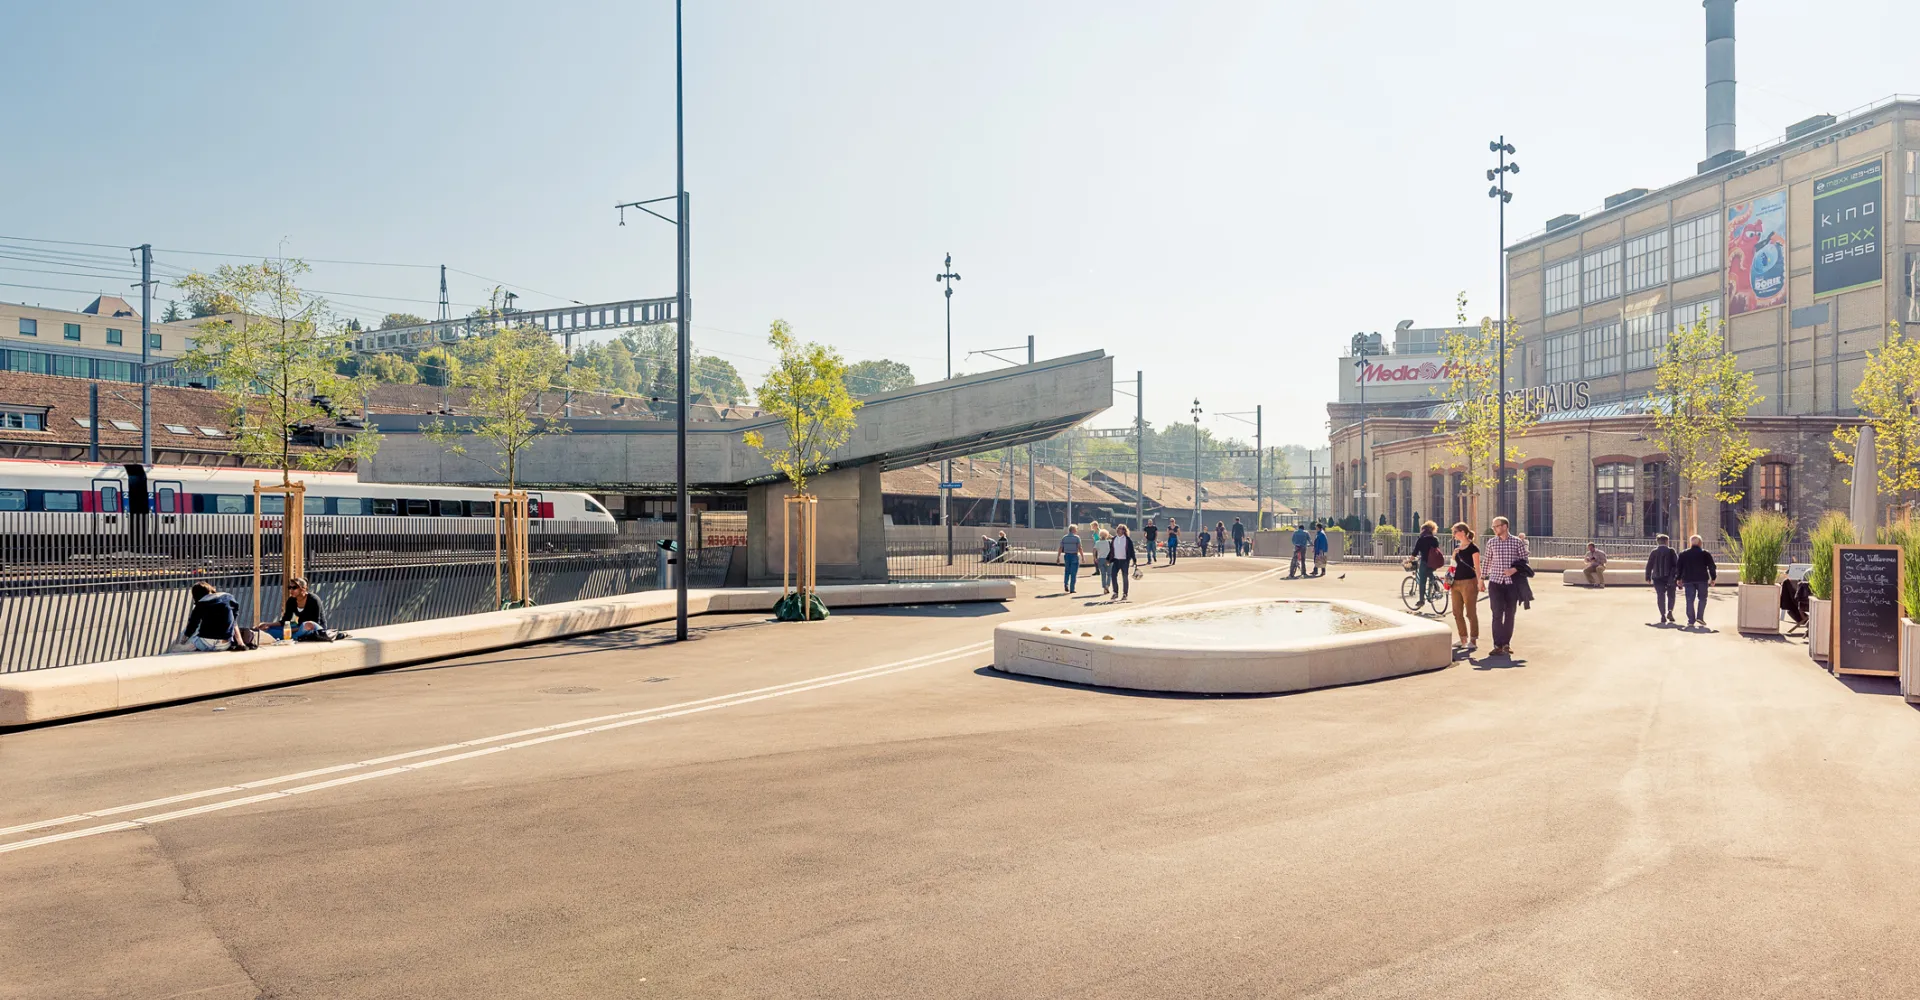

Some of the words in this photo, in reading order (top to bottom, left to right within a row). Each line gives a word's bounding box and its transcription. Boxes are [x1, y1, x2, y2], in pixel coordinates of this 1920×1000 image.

[1826, 175, 1849, 188] maxx
[1851, 165, 1881, 180] 123456
[1821, 201, 1875, 228] kino
[1821, 226, 1875, 251] maxx
[1821, 242, 1875, 265] 123456
[1356, 363, 1419, 383] Media
